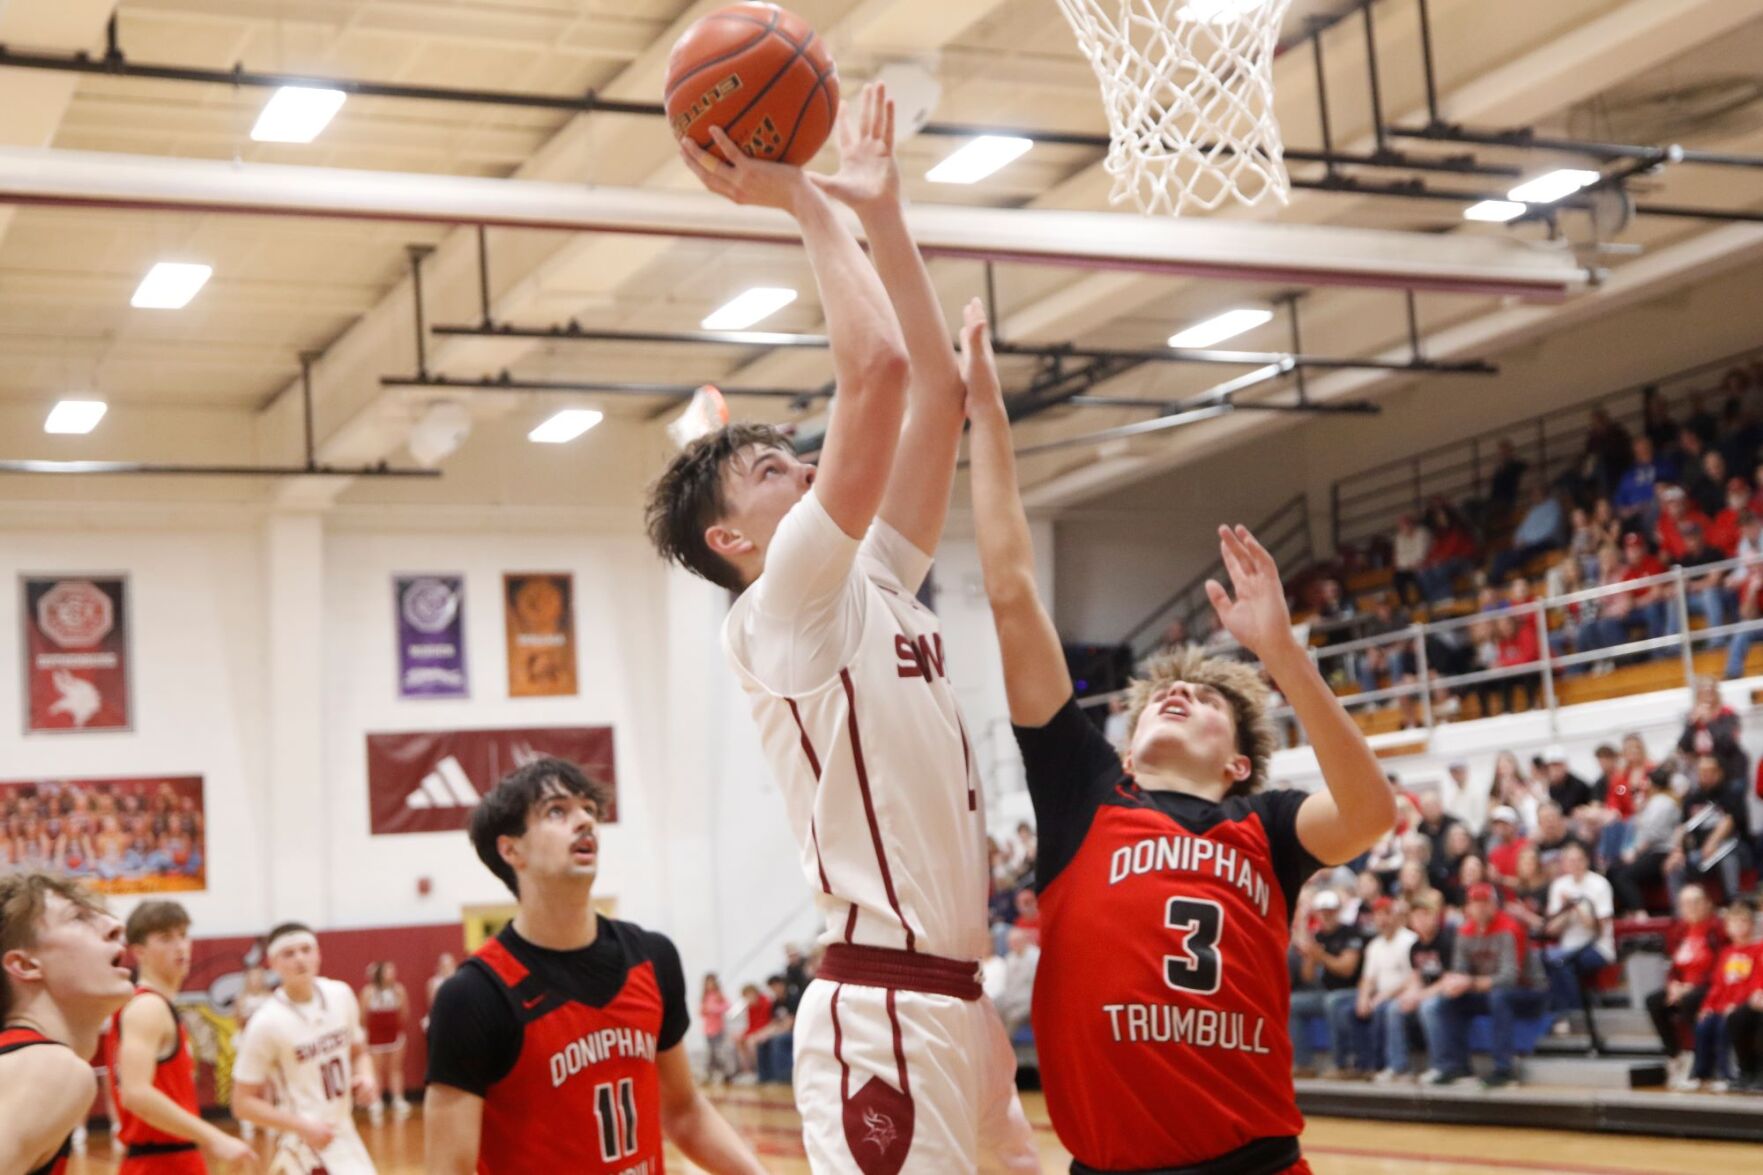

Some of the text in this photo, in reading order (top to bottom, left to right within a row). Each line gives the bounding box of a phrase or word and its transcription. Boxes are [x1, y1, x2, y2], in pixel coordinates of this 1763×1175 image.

[1109, 836, 1270, 917] DONIPHAN
[1163, 895, 1225, 996] 3
[549, 1028, 656, 1088] DONIPHAN
[1103, 1003, 1270, 1054] TRUMBULL
[594, 1077, 638, 1163] 11
